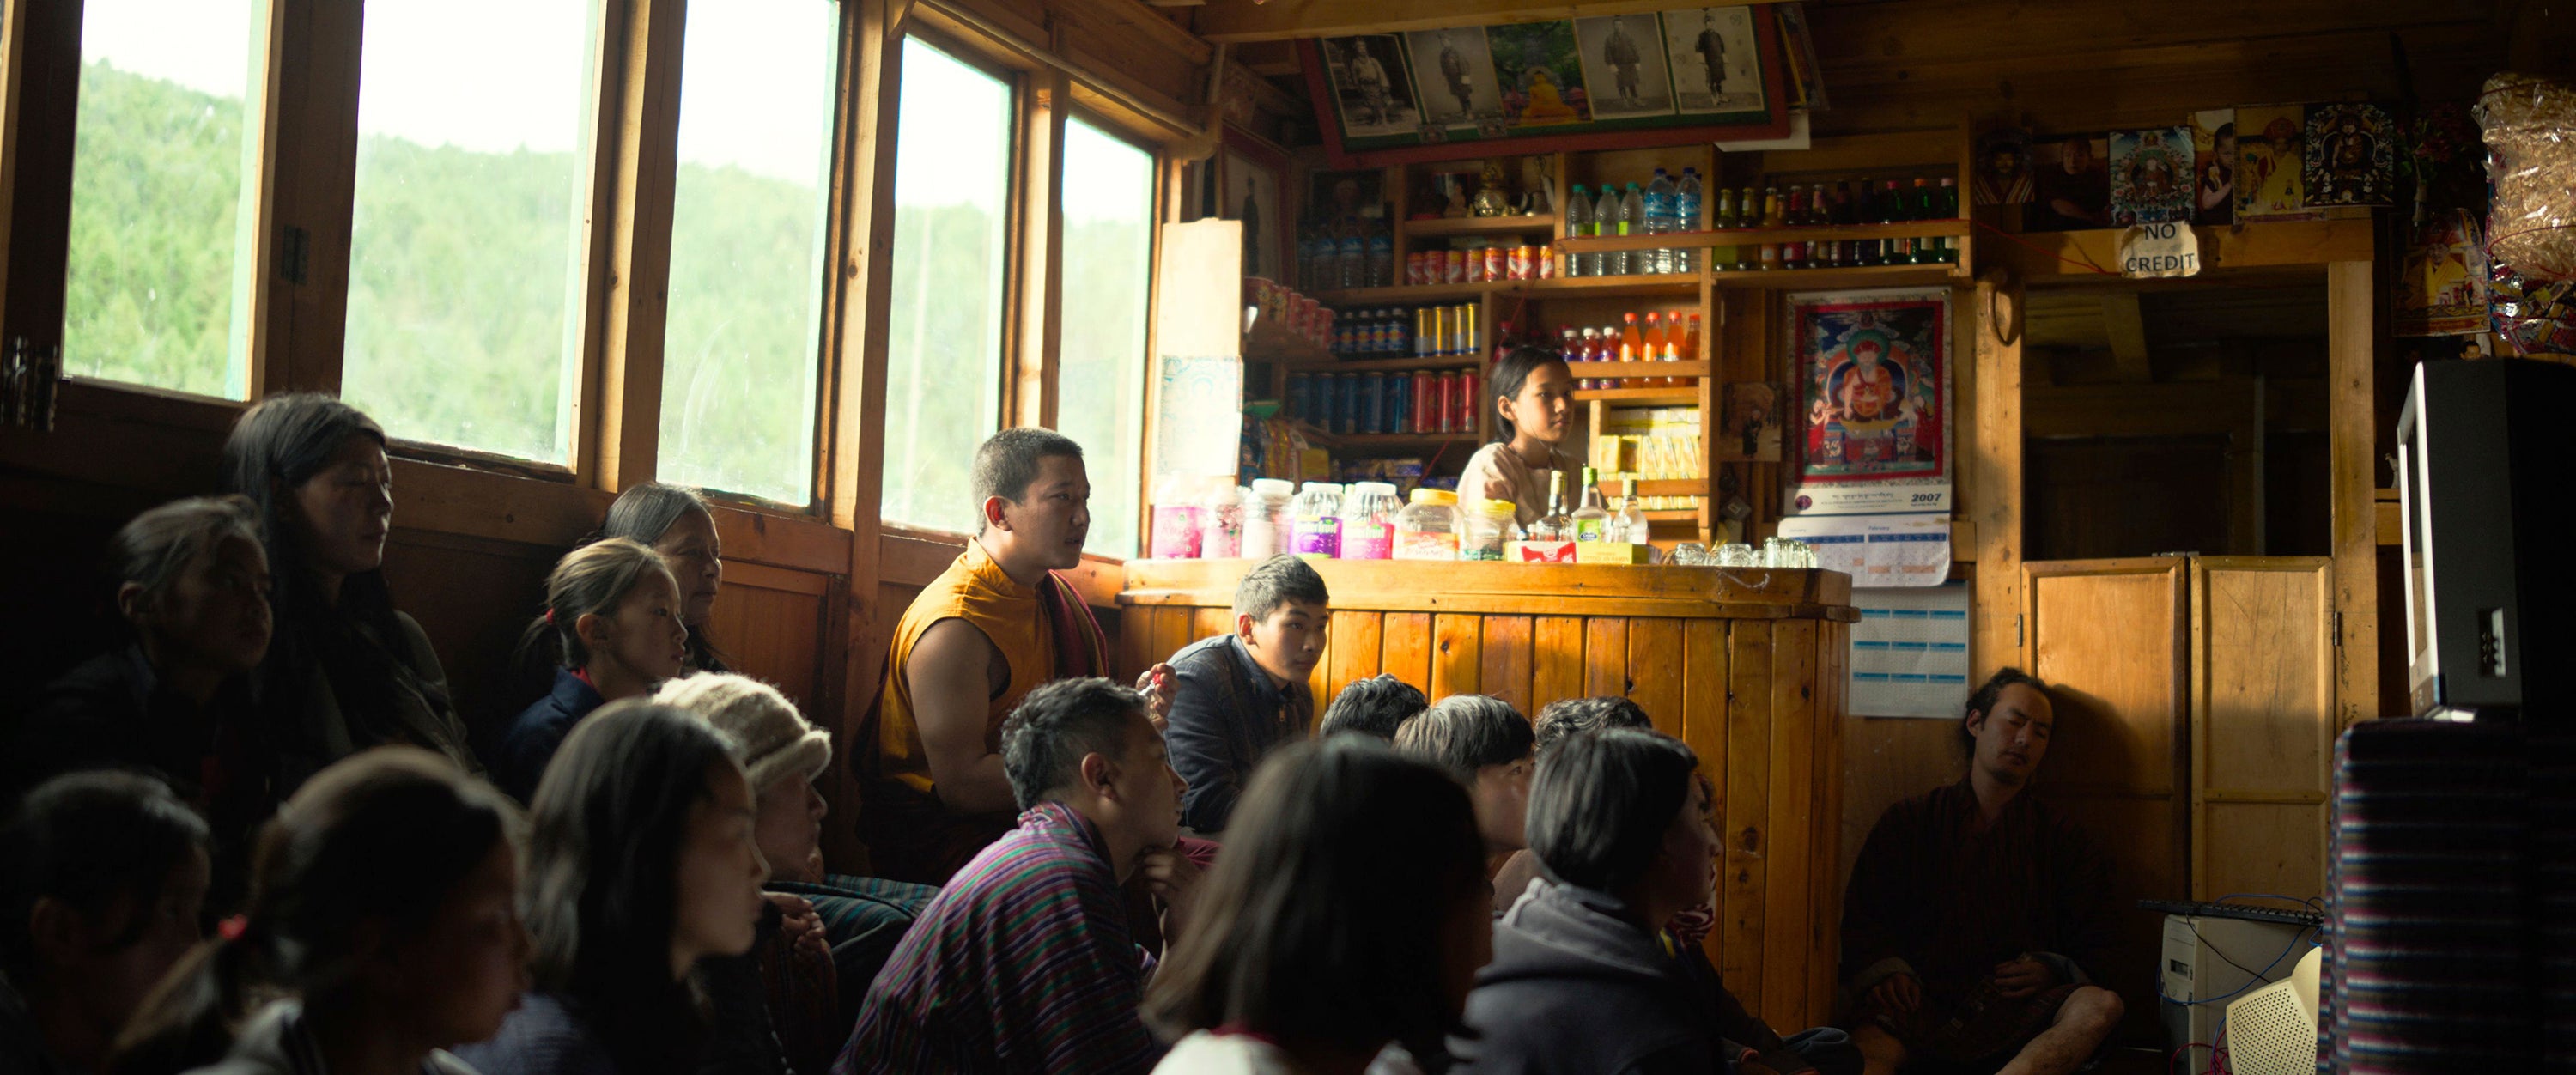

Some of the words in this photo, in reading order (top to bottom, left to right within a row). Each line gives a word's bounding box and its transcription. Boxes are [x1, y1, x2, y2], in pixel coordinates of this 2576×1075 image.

[2145, 223, 2176, 240] NO
[2125, 252, 2195, 272] CREDIT
[1911, 493, 1942, 502] 2007
